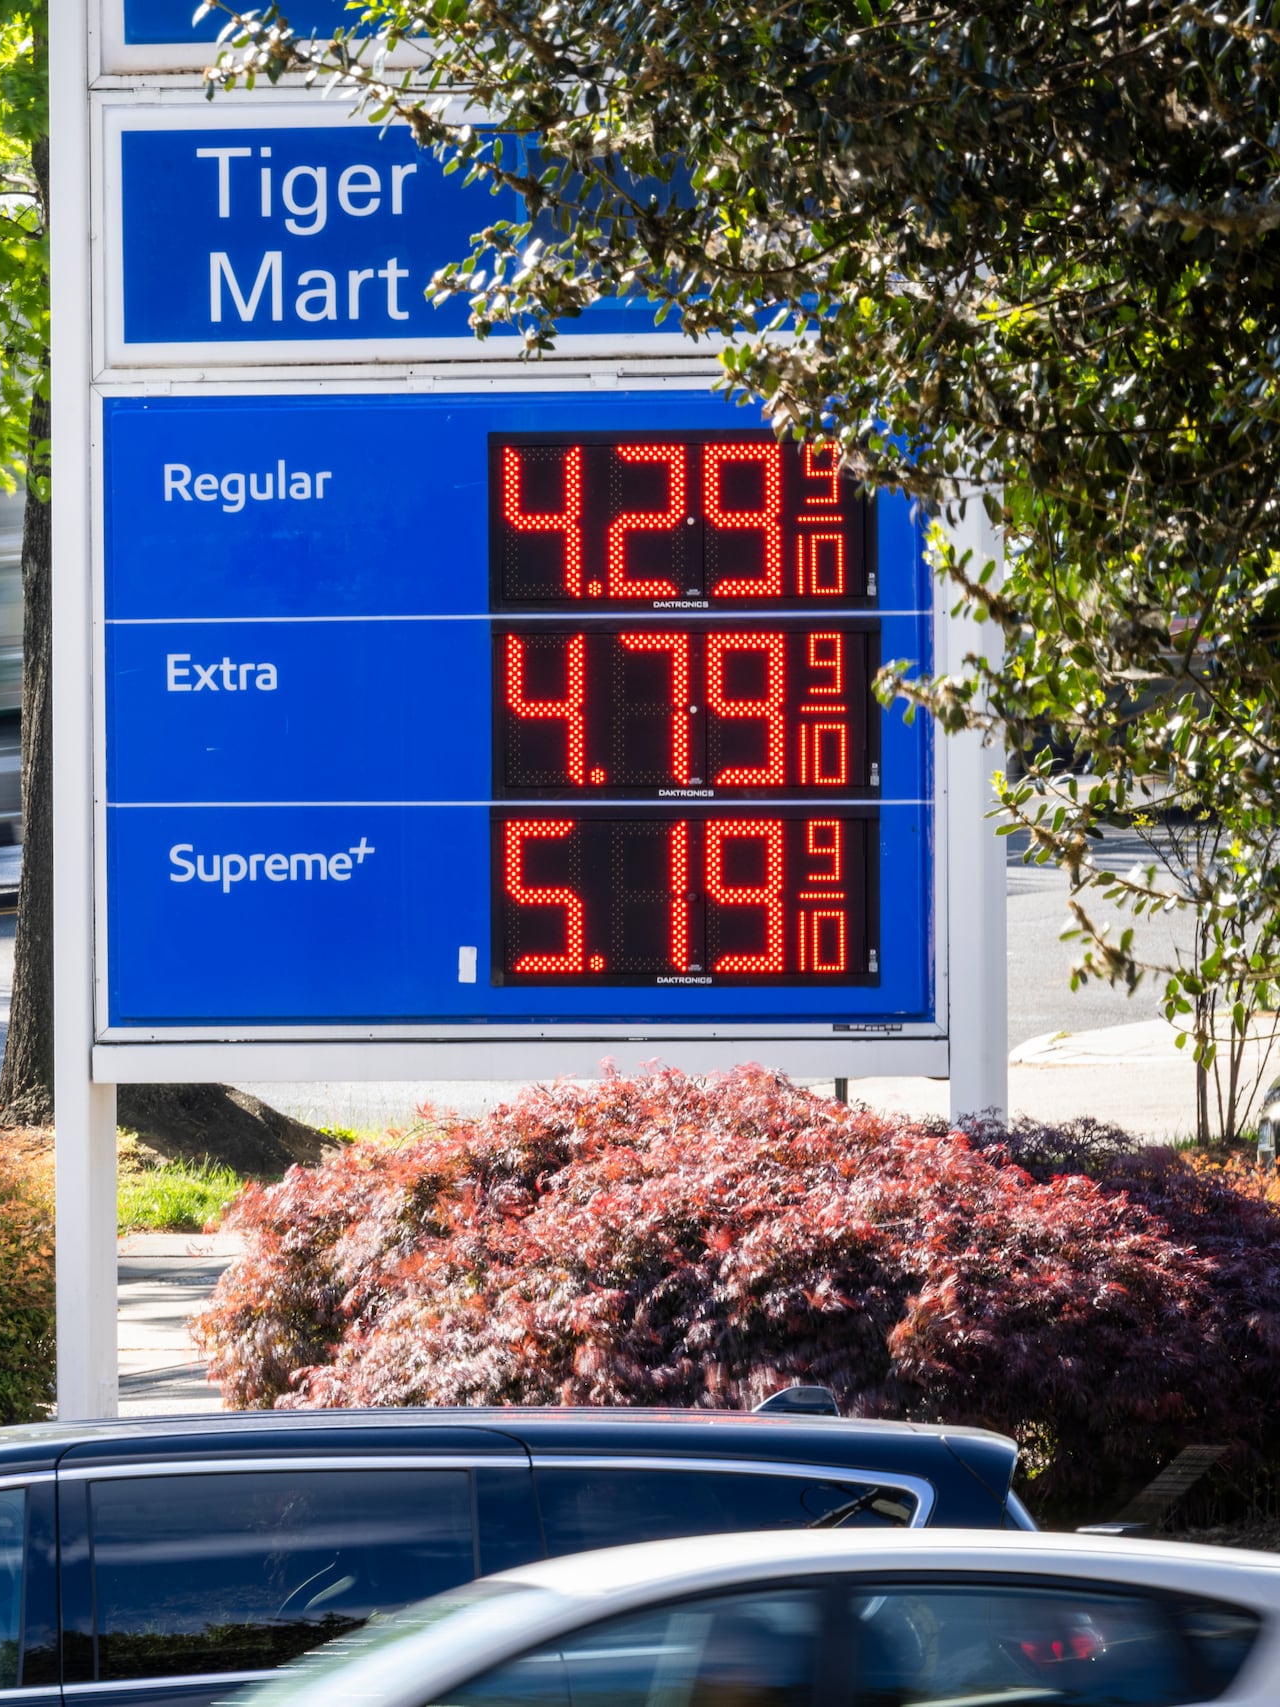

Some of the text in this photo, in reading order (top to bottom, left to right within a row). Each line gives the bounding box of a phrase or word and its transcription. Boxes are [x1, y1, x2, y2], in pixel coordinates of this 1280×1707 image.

[196, 146, 417, 236] Tiger
[209, 251, 409, 323] Mart
[163, 459, 332, 513] Regular
[805, 443, 841, 505] 9
[504, 443, 783, 598] 4.29
[796, 533, 845, 595] 10
[653, 600, 709, 609] DAKTRONICS
[166, 653, 278, 692] Extra
[506, 632, 847, 786] 4.79 9 10
[658, 788, 715, 798] DAKTRONICS
[169, 837, 375, 893] Supreme+
[504, 820, 846, 973] 5.19 9 10
[656, 976, 713, 985] DAKTRONICS
